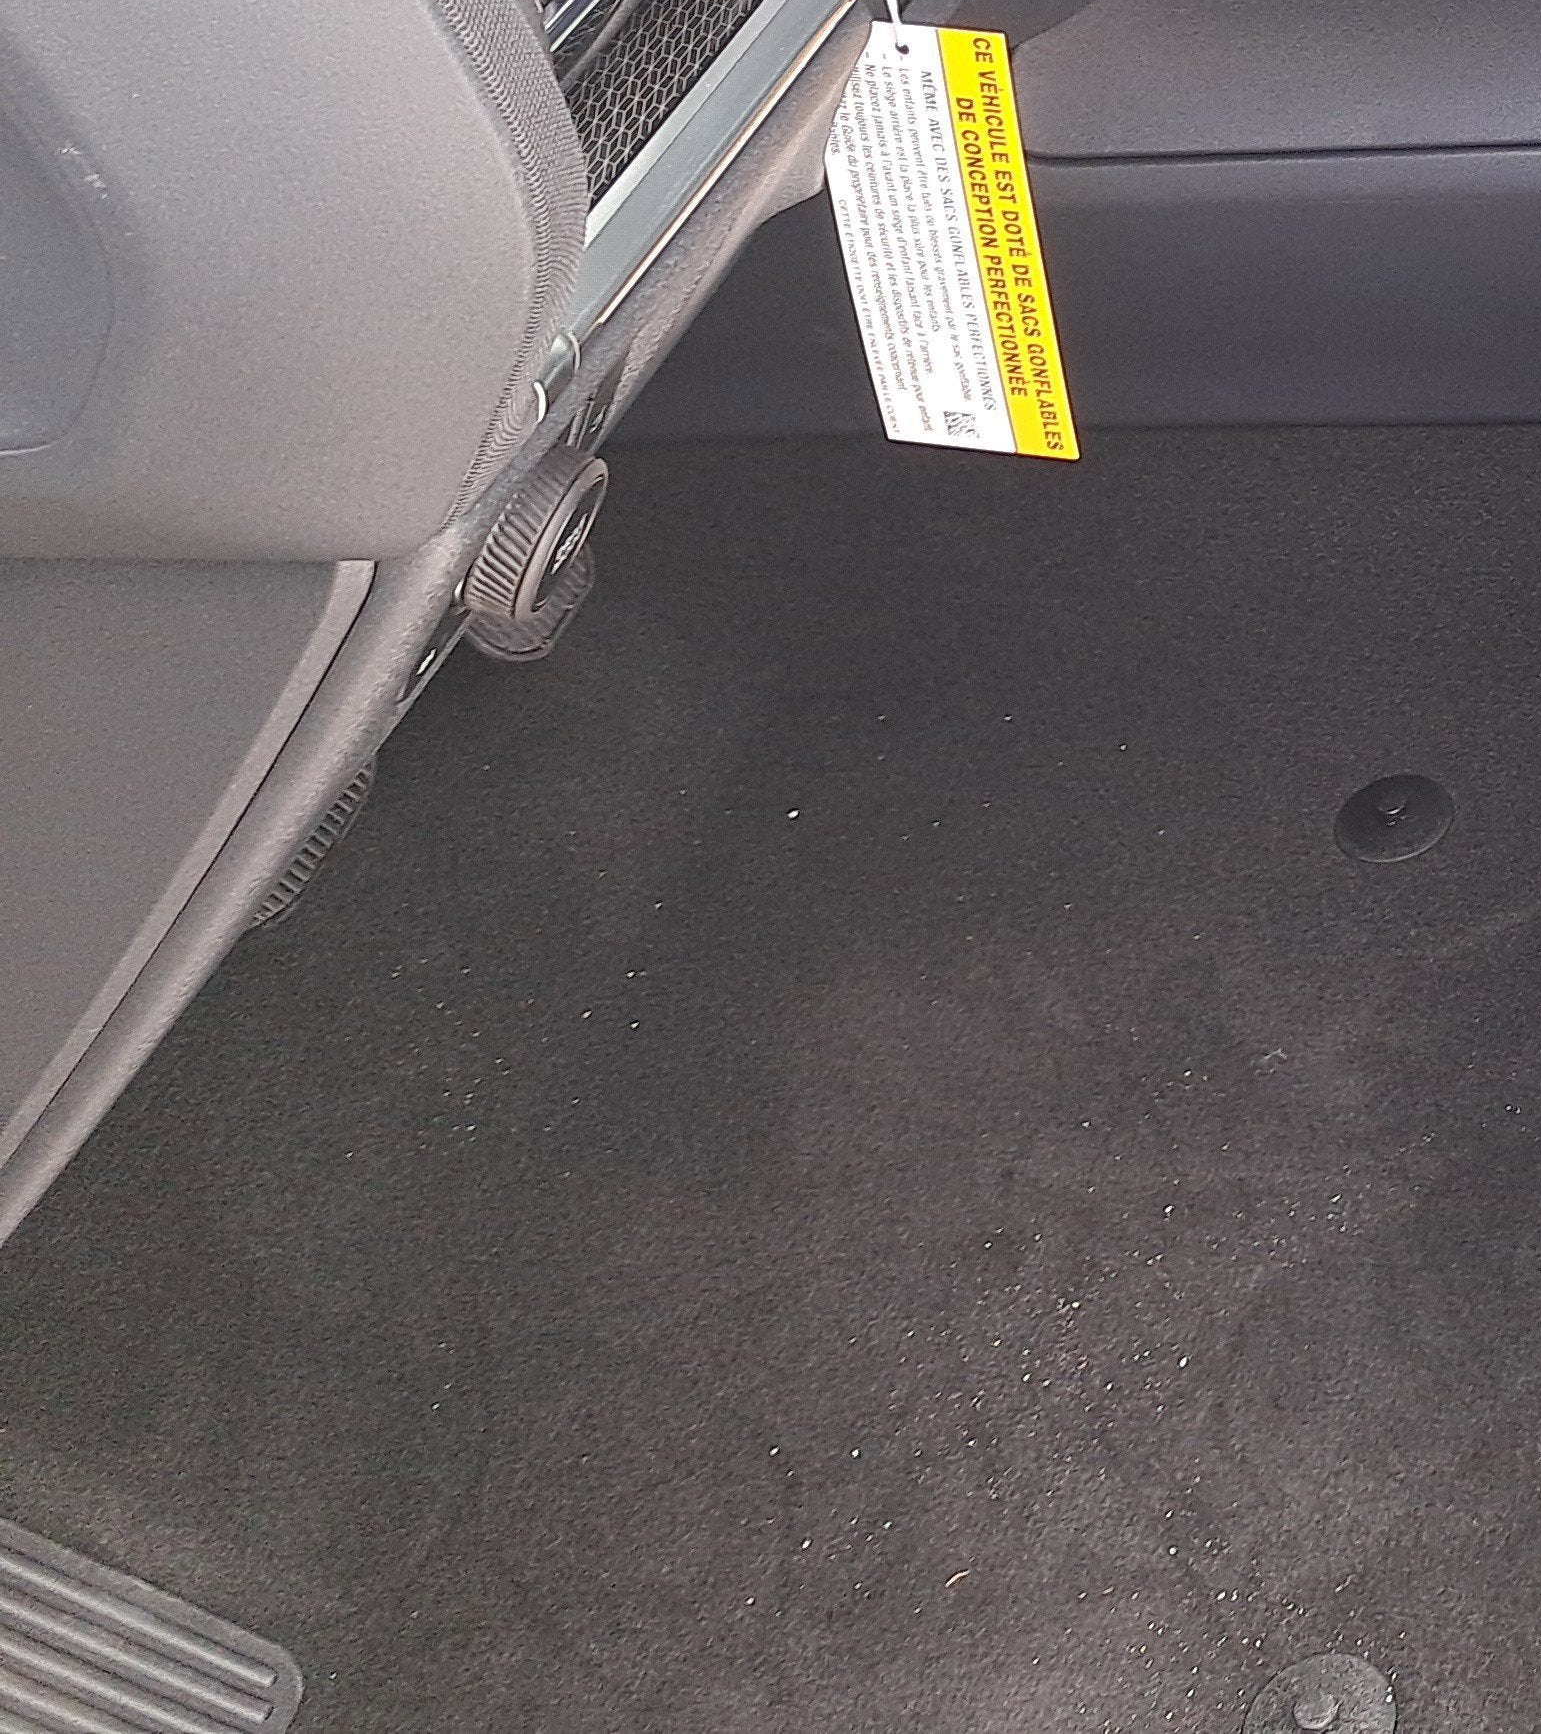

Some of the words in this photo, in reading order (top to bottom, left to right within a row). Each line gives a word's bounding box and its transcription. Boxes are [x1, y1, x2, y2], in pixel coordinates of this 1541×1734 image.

[970, 36, 994, 63] CE
[918, 70, 941, 112] MÊME
[953, 96, 977, 123] DE
[926, 117, 945, 152] AVEC
[974, 68, 1018, 164] VÉHICULE
[933, 156, 951, 182] DES
[958, 128, 1001, 249] CONCEPTION
[992, 169, 1017, 204] EST
[939, 187, 958, 221] SACS
[999, 209, 1032, 258] DOTÉ
[946, 226, 975, 309] GONFLABLES
[1010, 263, 1033, 287] DE
[982, 254, 1033, 397] PERFECTIONNÉE
[1015, 292, 1042, 337] SACS
[1025, 342, 1064, 450] GONFLABLES
